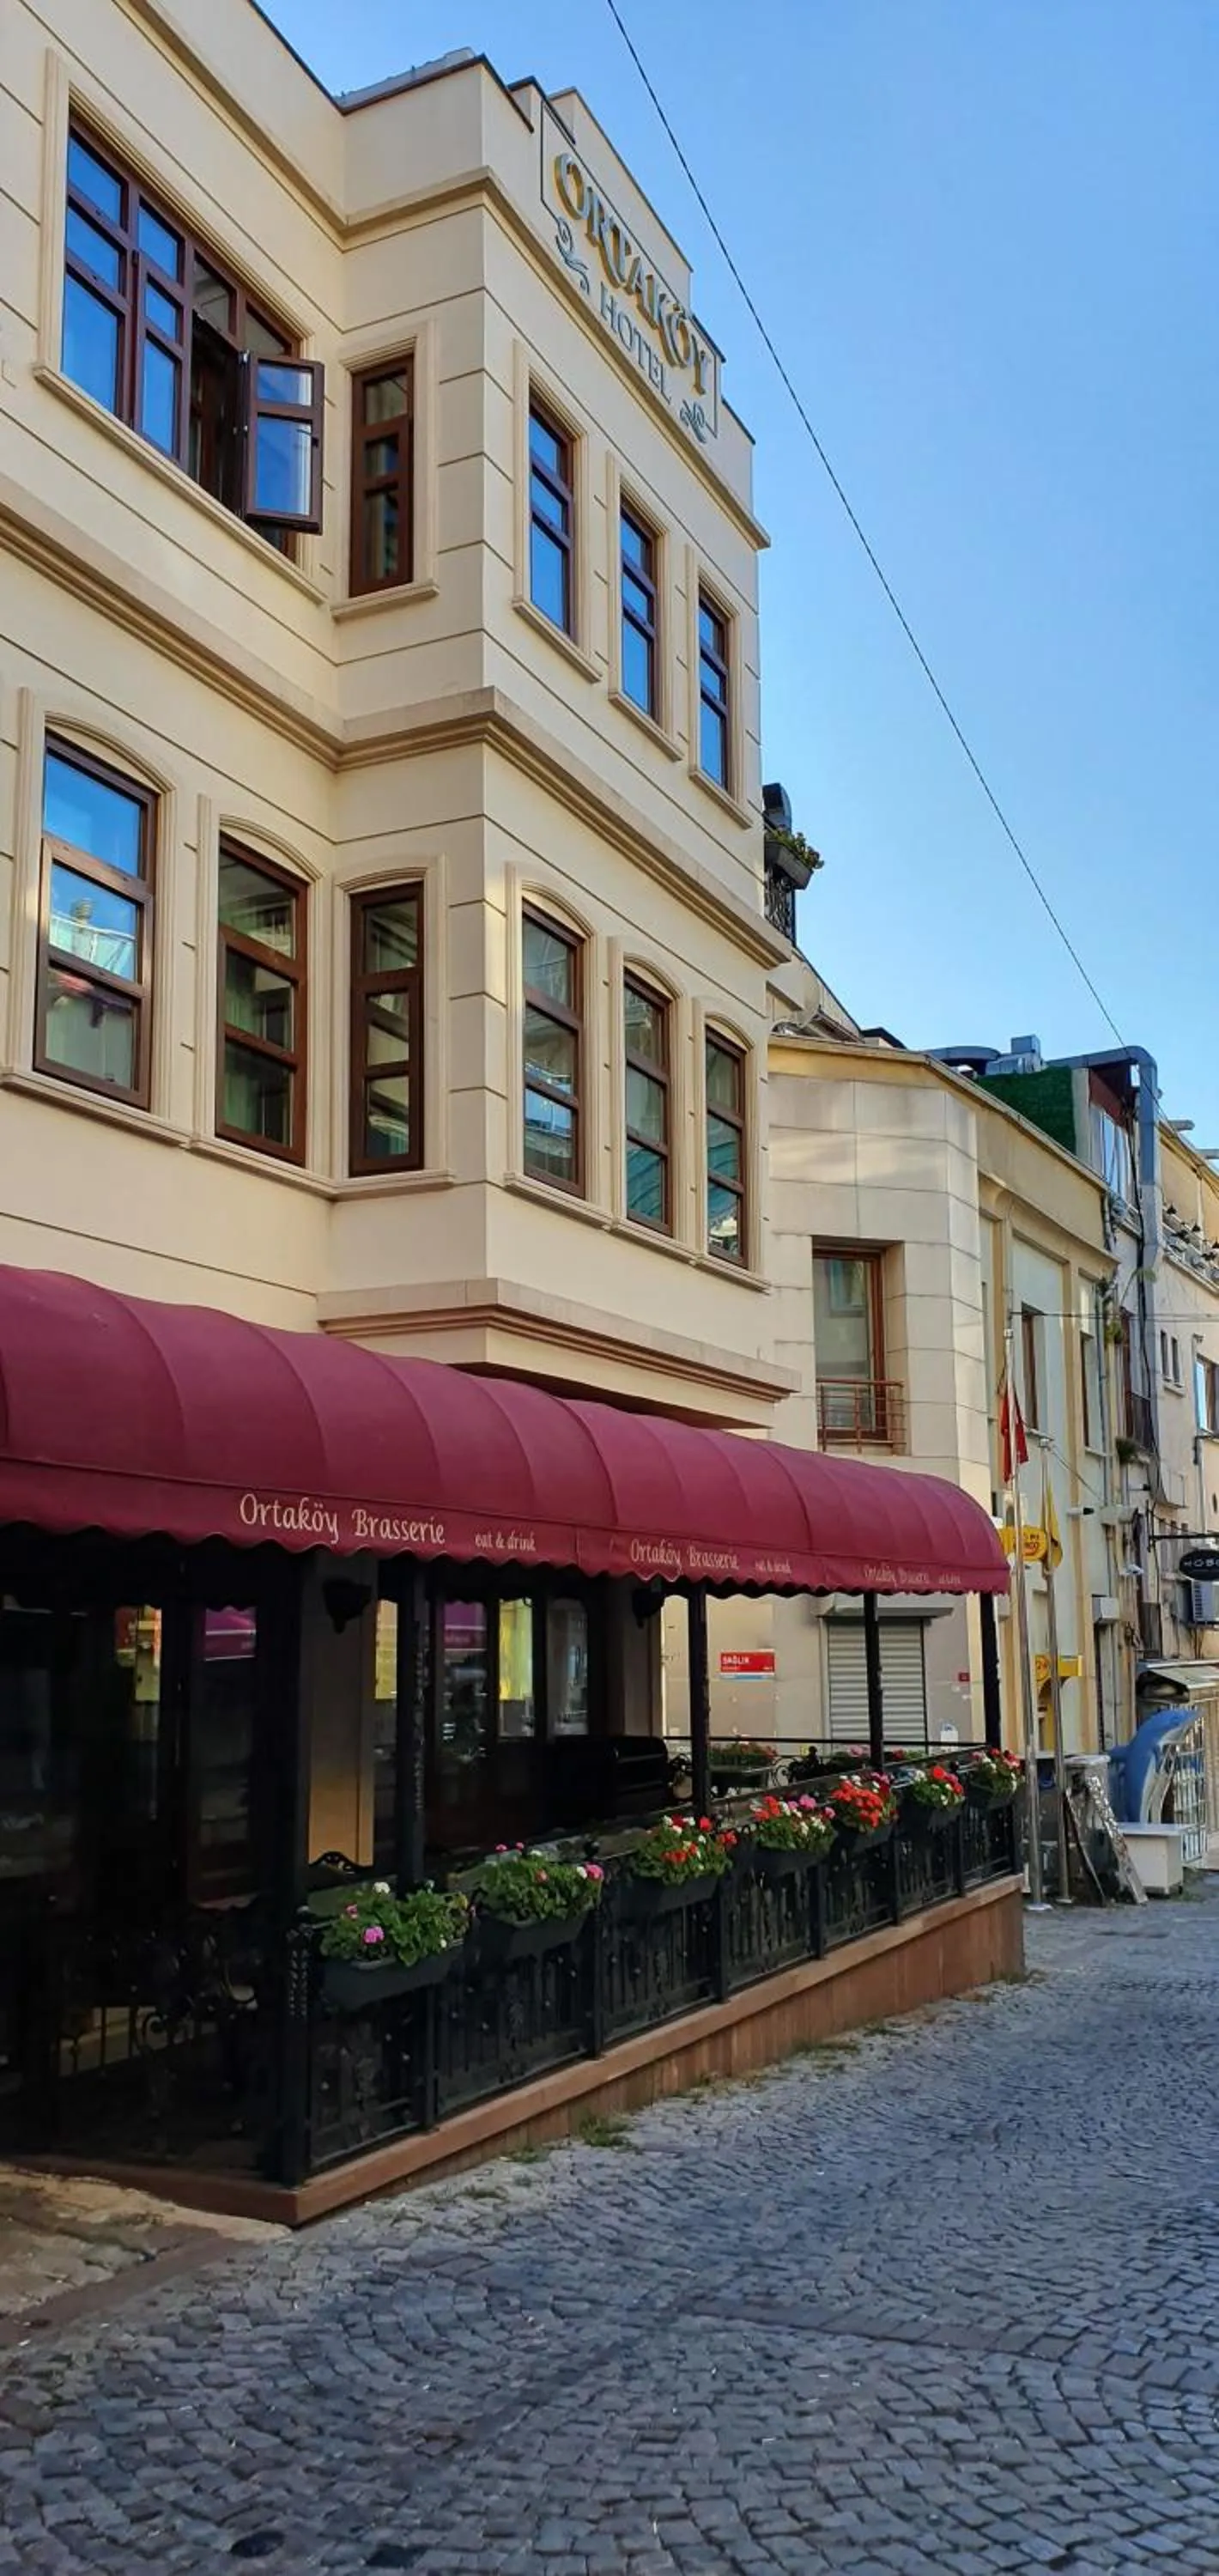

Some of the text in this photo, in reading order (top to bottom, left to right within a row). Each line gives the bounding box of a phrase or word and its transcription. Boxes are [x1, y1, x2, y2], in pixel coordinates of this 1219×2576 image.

[554, 151, 713, 395] ORTAKÖY
[600, 282, 672, 405] HOTEL
[240, 1493, 446, 1545] Ortaköy Brasserie
[476, 1529, 536, 1552] eat & drink
[631, 1538, 682, 1573] Ortaköy
[688, 1546, 739, 1570] Brasserie
